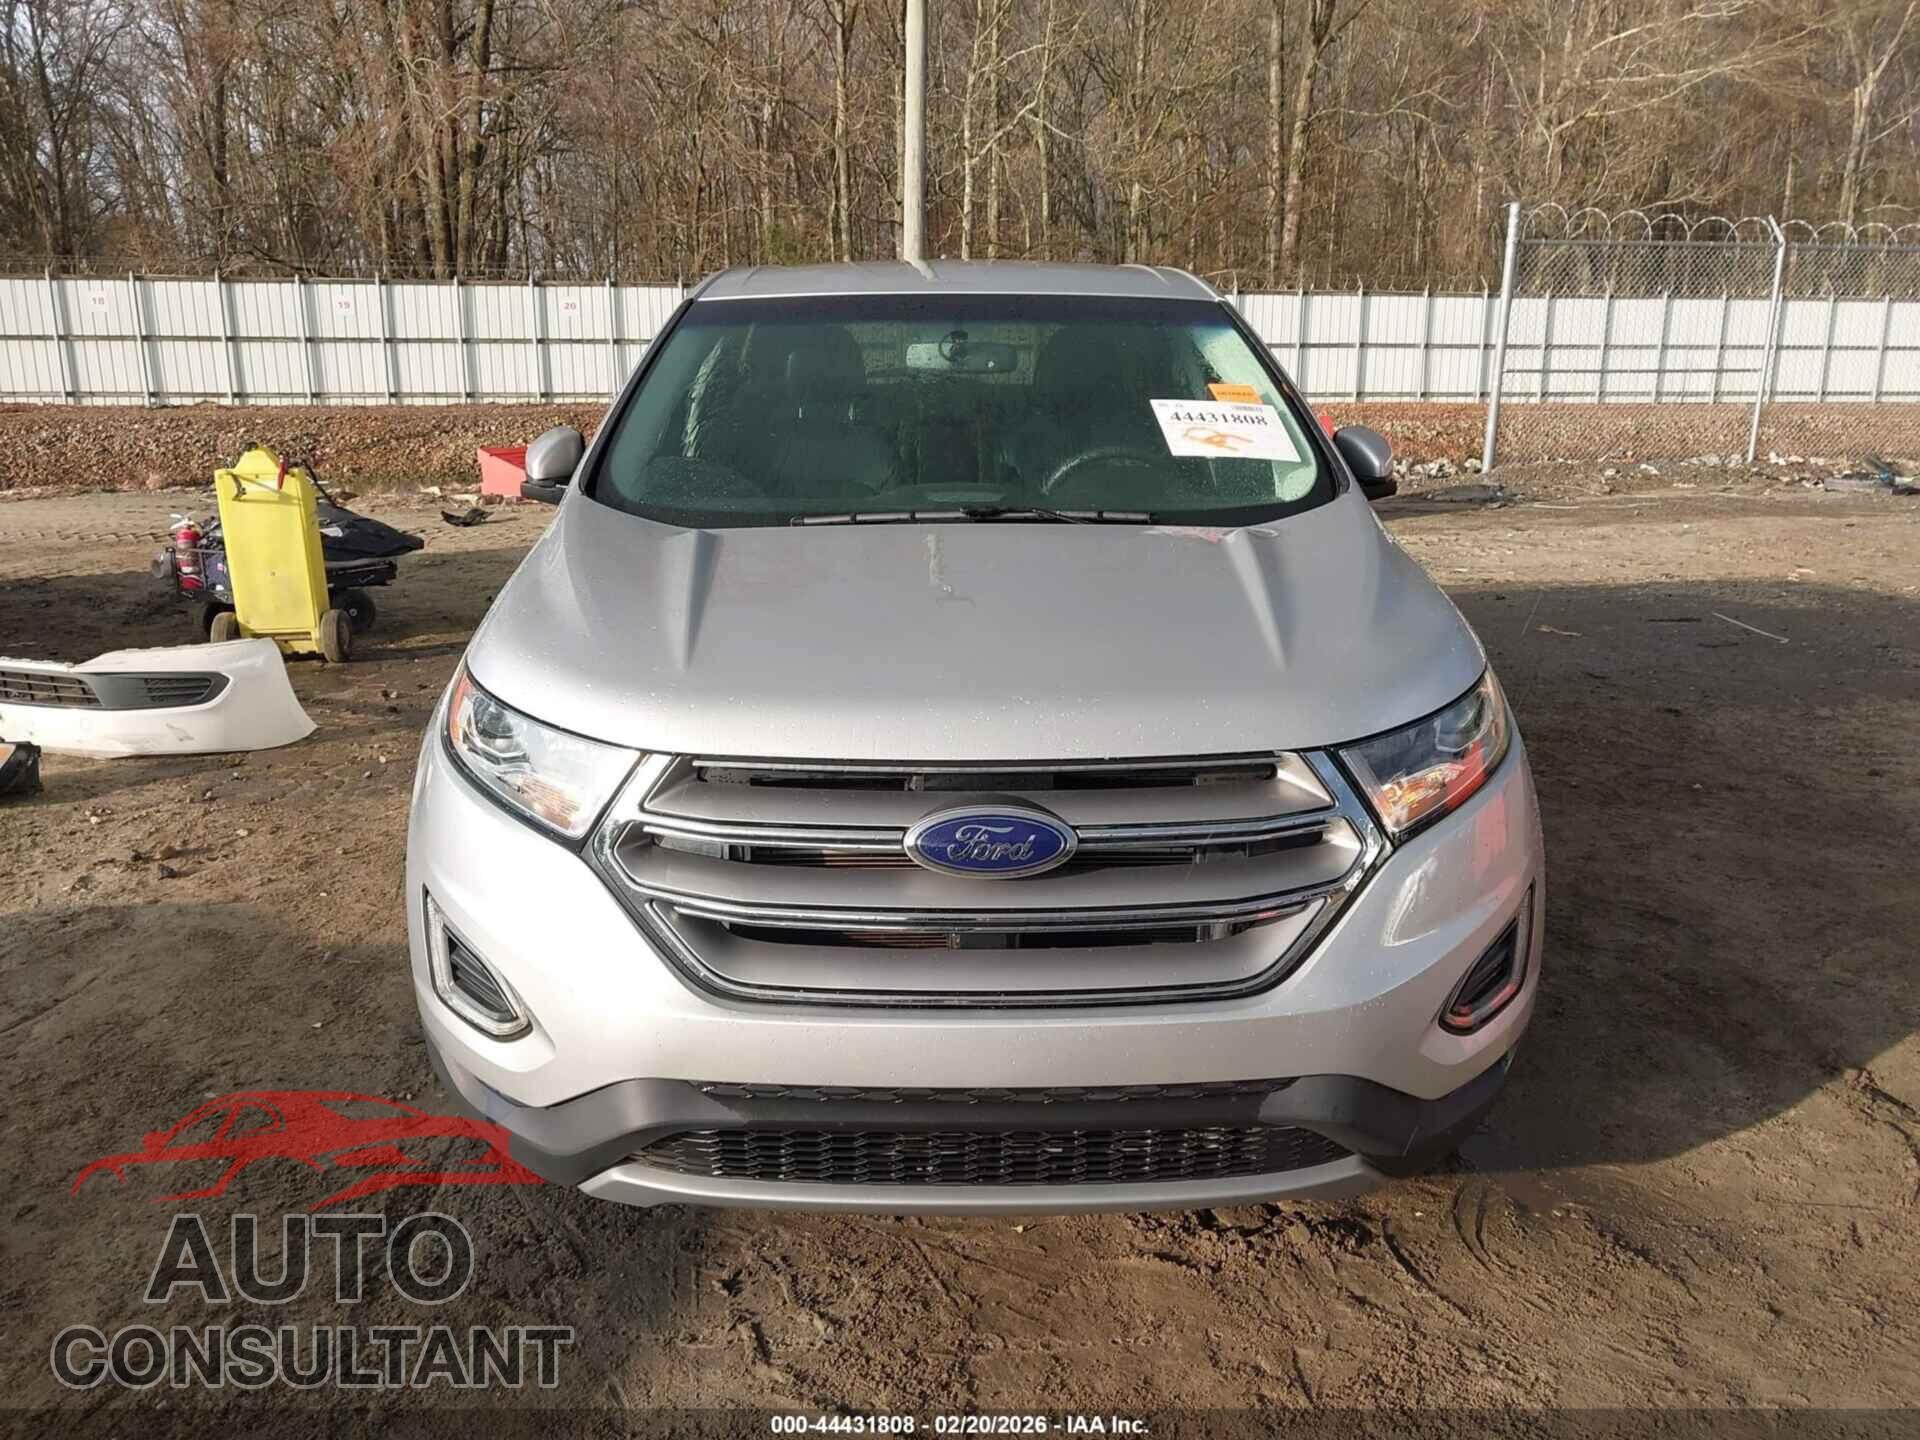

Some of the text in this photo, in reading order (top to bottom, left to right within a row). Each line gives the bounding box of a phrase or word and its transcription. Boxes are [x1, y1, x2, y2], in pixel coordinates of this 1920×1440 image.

[563, 301, 577, 310] 20
[1170, 411, 1268, 426] 44431808
[947, 824, 1037, 862] Ford
